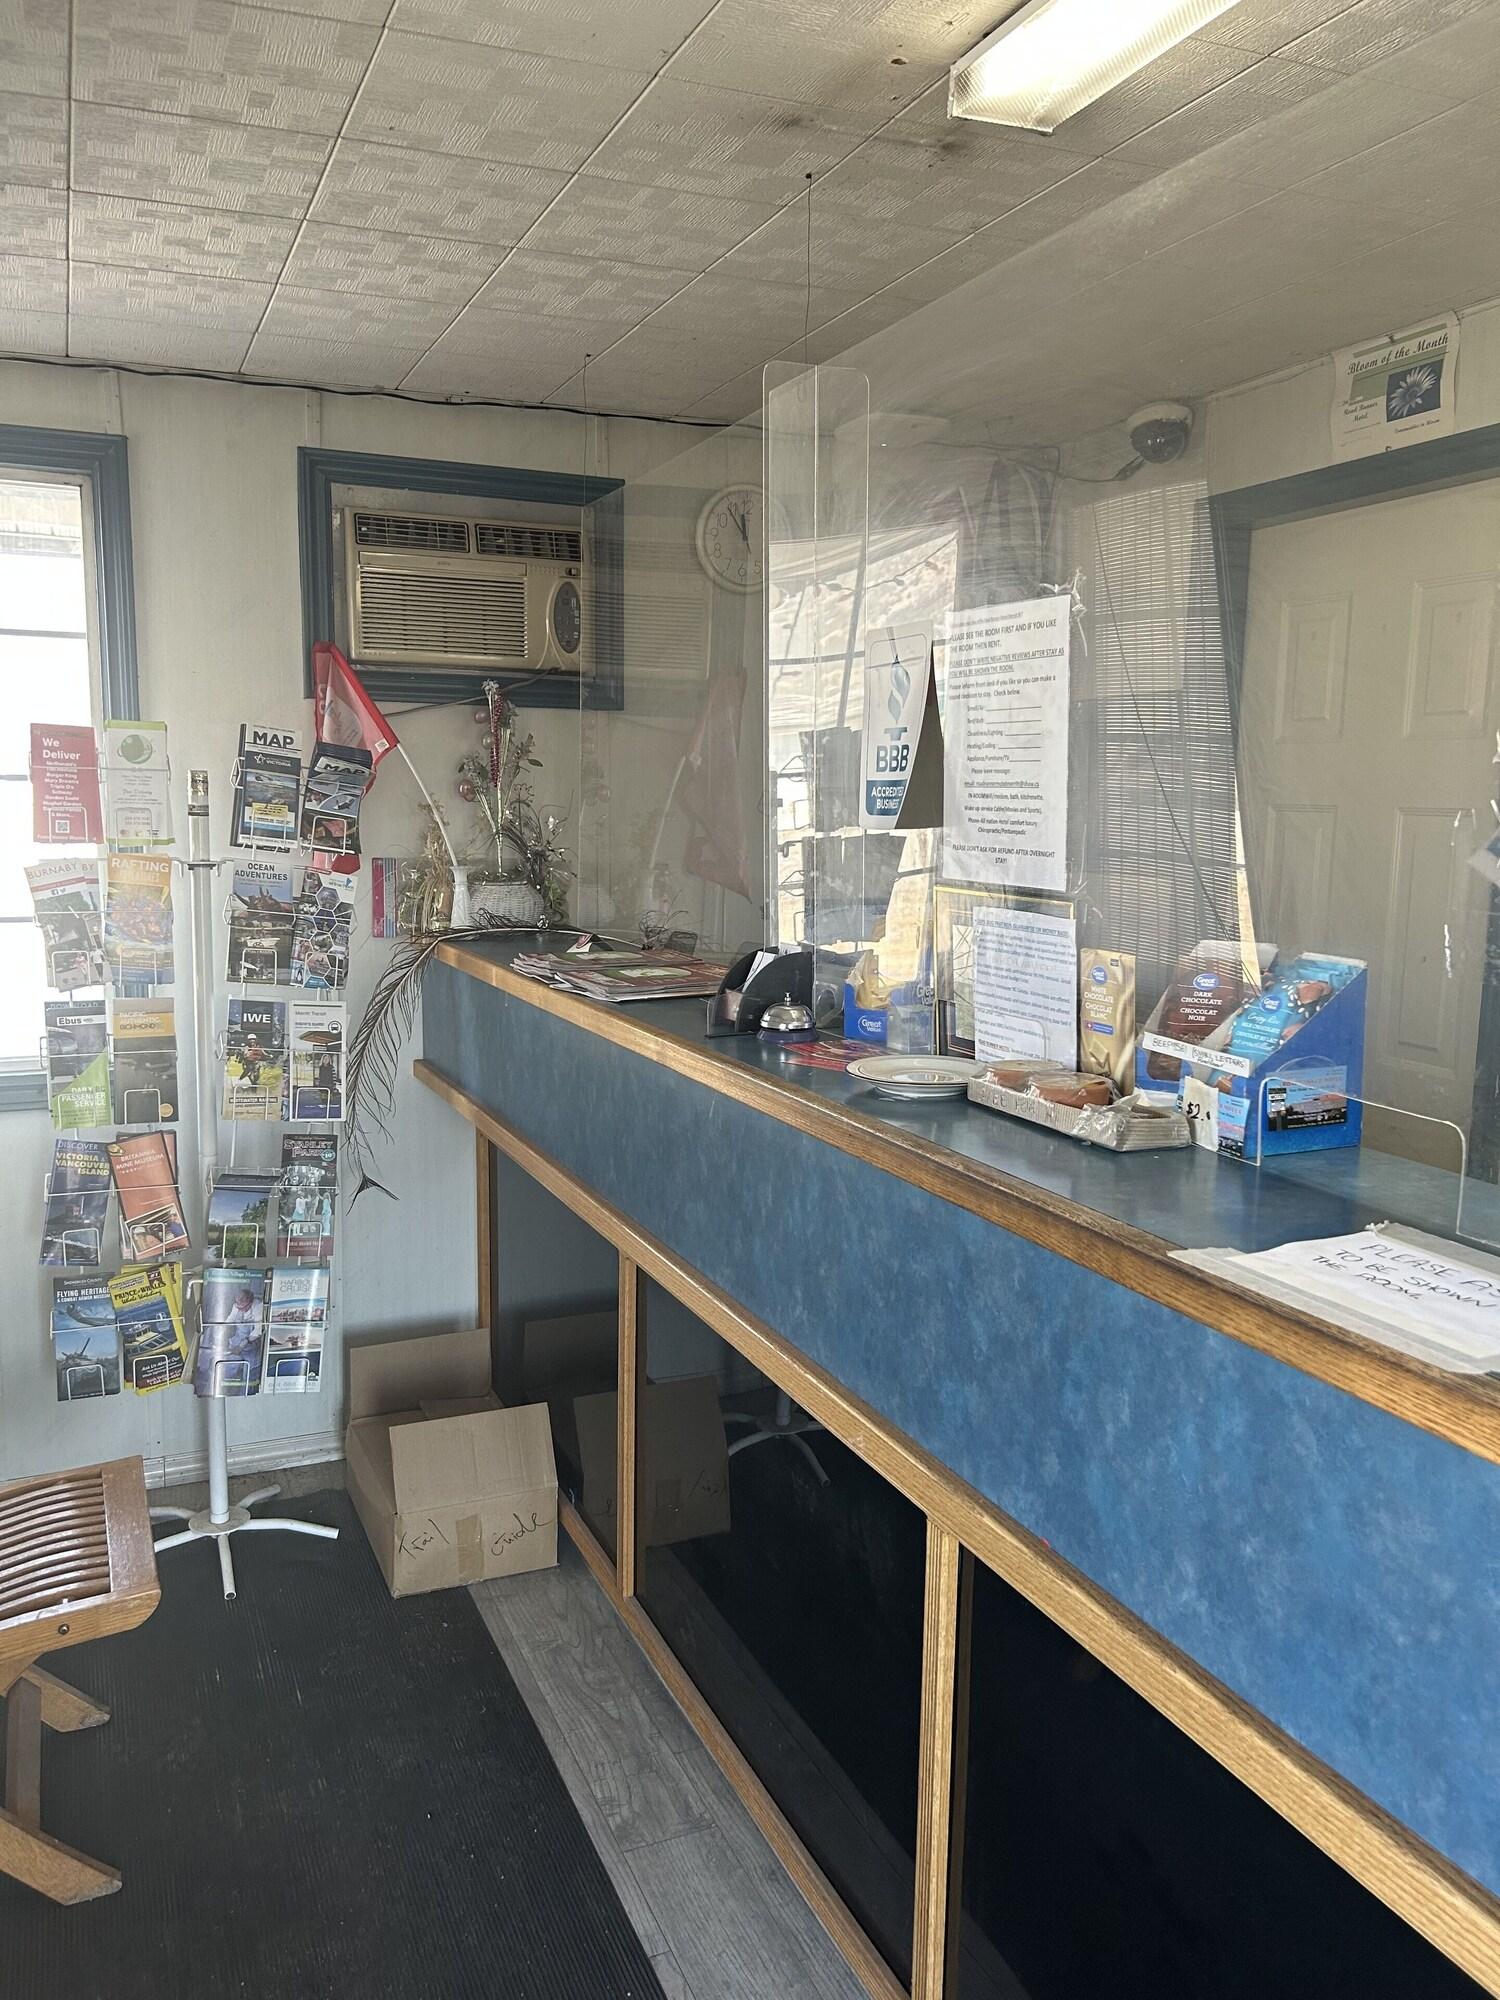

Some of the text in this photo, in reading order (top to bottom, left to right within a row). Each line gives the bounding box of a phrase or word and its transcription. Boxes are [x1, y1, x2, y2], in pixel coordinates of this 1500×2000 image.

[1347, 332, 1449, 376] Bloom of the Month
[716, 512, 728, 528] 10
[714, 542, 722, 558] 8
[738, 562, 748, 577] 6
[753, 560, 762, 576] 5
[966, 631, 974, 640] SEE
[975, 630, 984, 638] THE
[984, 628, 1000, 637] ROOM
[1001, 625, 1014, 634] FIRST
[1015, 624, 1026, 632] AND
[1028, 622, 1032, 630] IF
[1033, 621, 1045, 630] YOU
[1046, 618, 1056, 628] LIKE
[1032, 649, 1045, 658] AFTER
[1046, 648, 1058, 656] STAY
[1058, 647, 1064, 655] AS
[42, 737, 60, 748] We
[252, 730, 295, 748] MAP
[42, 749, 80, 760] Deliver
[876, 744, 910, 772] BBB
[323, 764, 366, 775] MAP
[952, 844, 966, 852] PLEASE
[988, 846, 997, 854] FOR
[998, 847, 1014, 855] REFUND
[1015, 848, 1028, 856] AFTER
[1029, 850, 1056, 858] OVERNIGHT
[27, 862, 95, 880] BURNABY BY
[112, 858, 170, 873] RAFTING
[247, 862, 275, 872] OCEAN
[234, 870, 288, 881] ADVENTURES
[1196, 976, 1217, 984] Great
[1084, 992, 1114, 1004] CHOCOLATE
[1180, 996, 1223, 1006] CHOCOLATE
[1085, 1002, 1112, 1014] CHOCOLAT
[1180, 1007, 1219, 1016] CHOCOLAT
[58, 1017, 82, 1025] Ebus
[243, 1012, 272, 1024] IWE
[862, 1018, 882, 1028] Great
[74, 1100, 107, 1108] SERVICE
[58, 1141, 98, 1150] DISCOVER
[284, 1138, 334, 1150] STANLEY
[56, 1152, 99, 1162] VICTORIA
[55, 1160, 110, 1170] VANCOUVER
[78, 1168, 110, 1176] ISLAND
[1312, 1255, 1348, 1272] THE
[1358, 1243, 1462, 1279] PLEASE
[1336, 1249, 1498, 1308] TO BE SHOWN
[56, 1286, 110, 1298] FLYING HERITAGE
[114, 1289, 138, 1301] PRINCE
